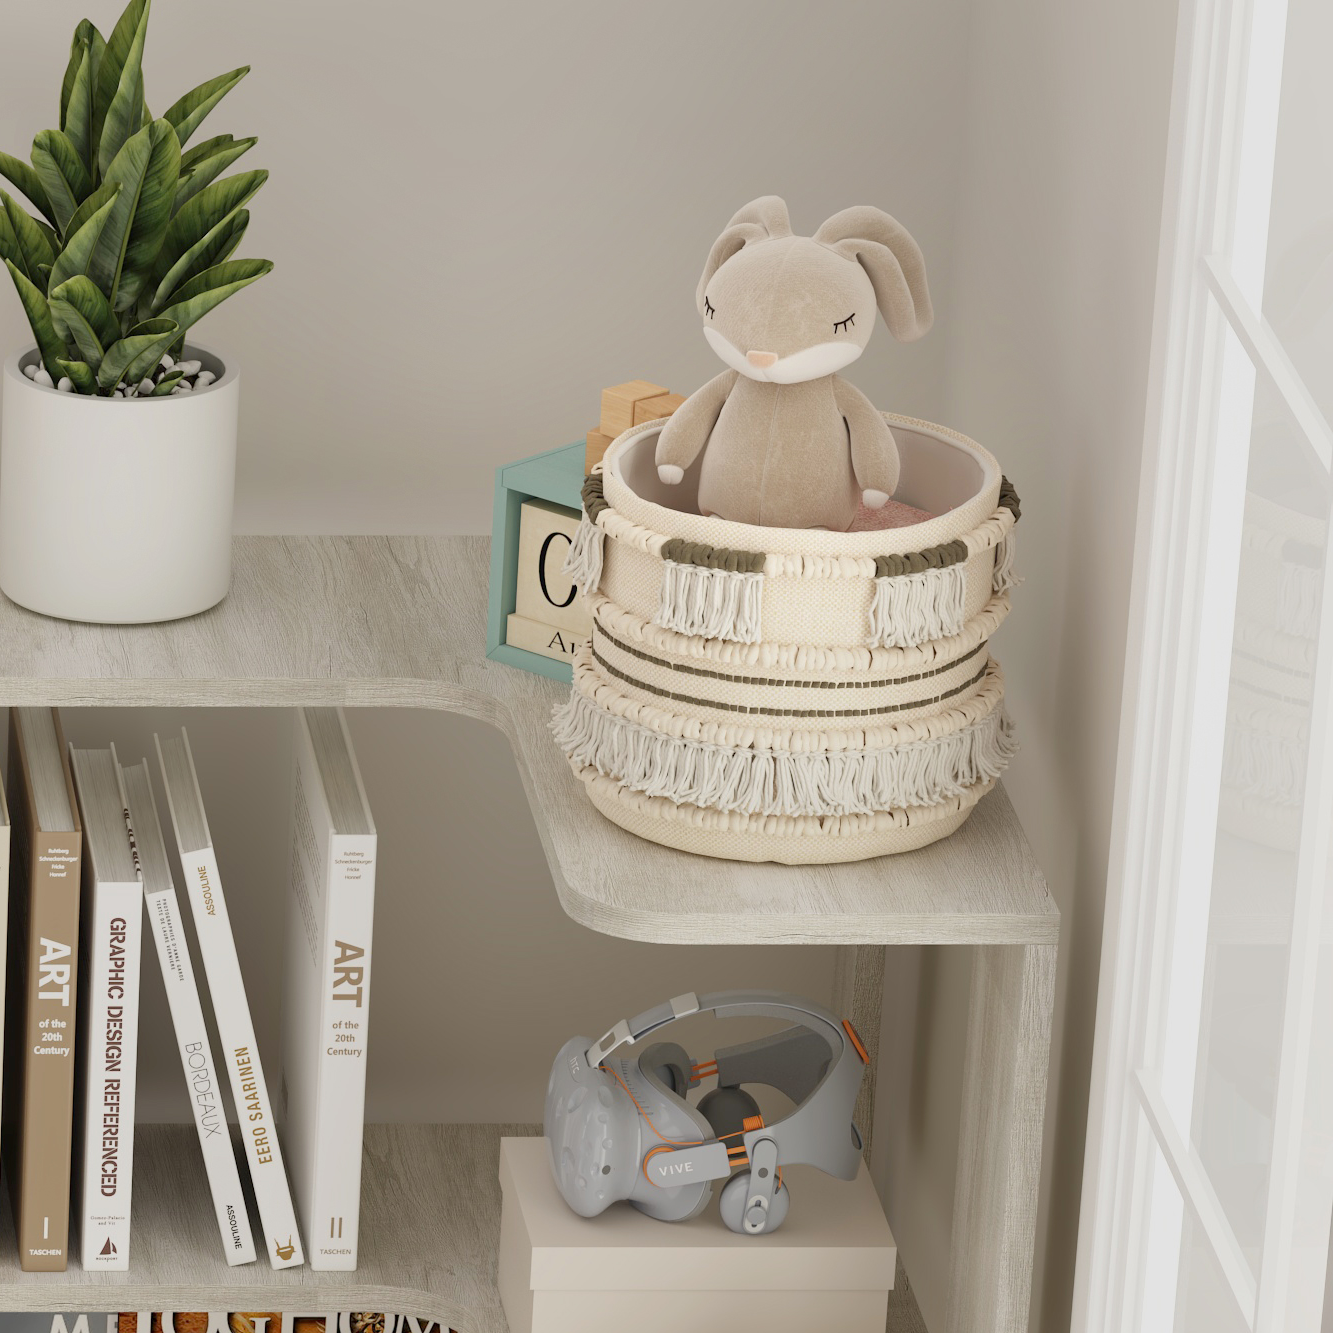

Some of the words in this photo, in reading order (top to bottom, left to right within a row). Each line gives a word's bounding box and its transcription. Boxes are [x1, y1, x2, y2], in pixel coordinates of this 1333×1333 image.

[107, 917, 127, 1000] GRAPHIC
[106, 1006, 124, 1073] DESIGN
[101, 1079, 120, 1197] REFERENCED
